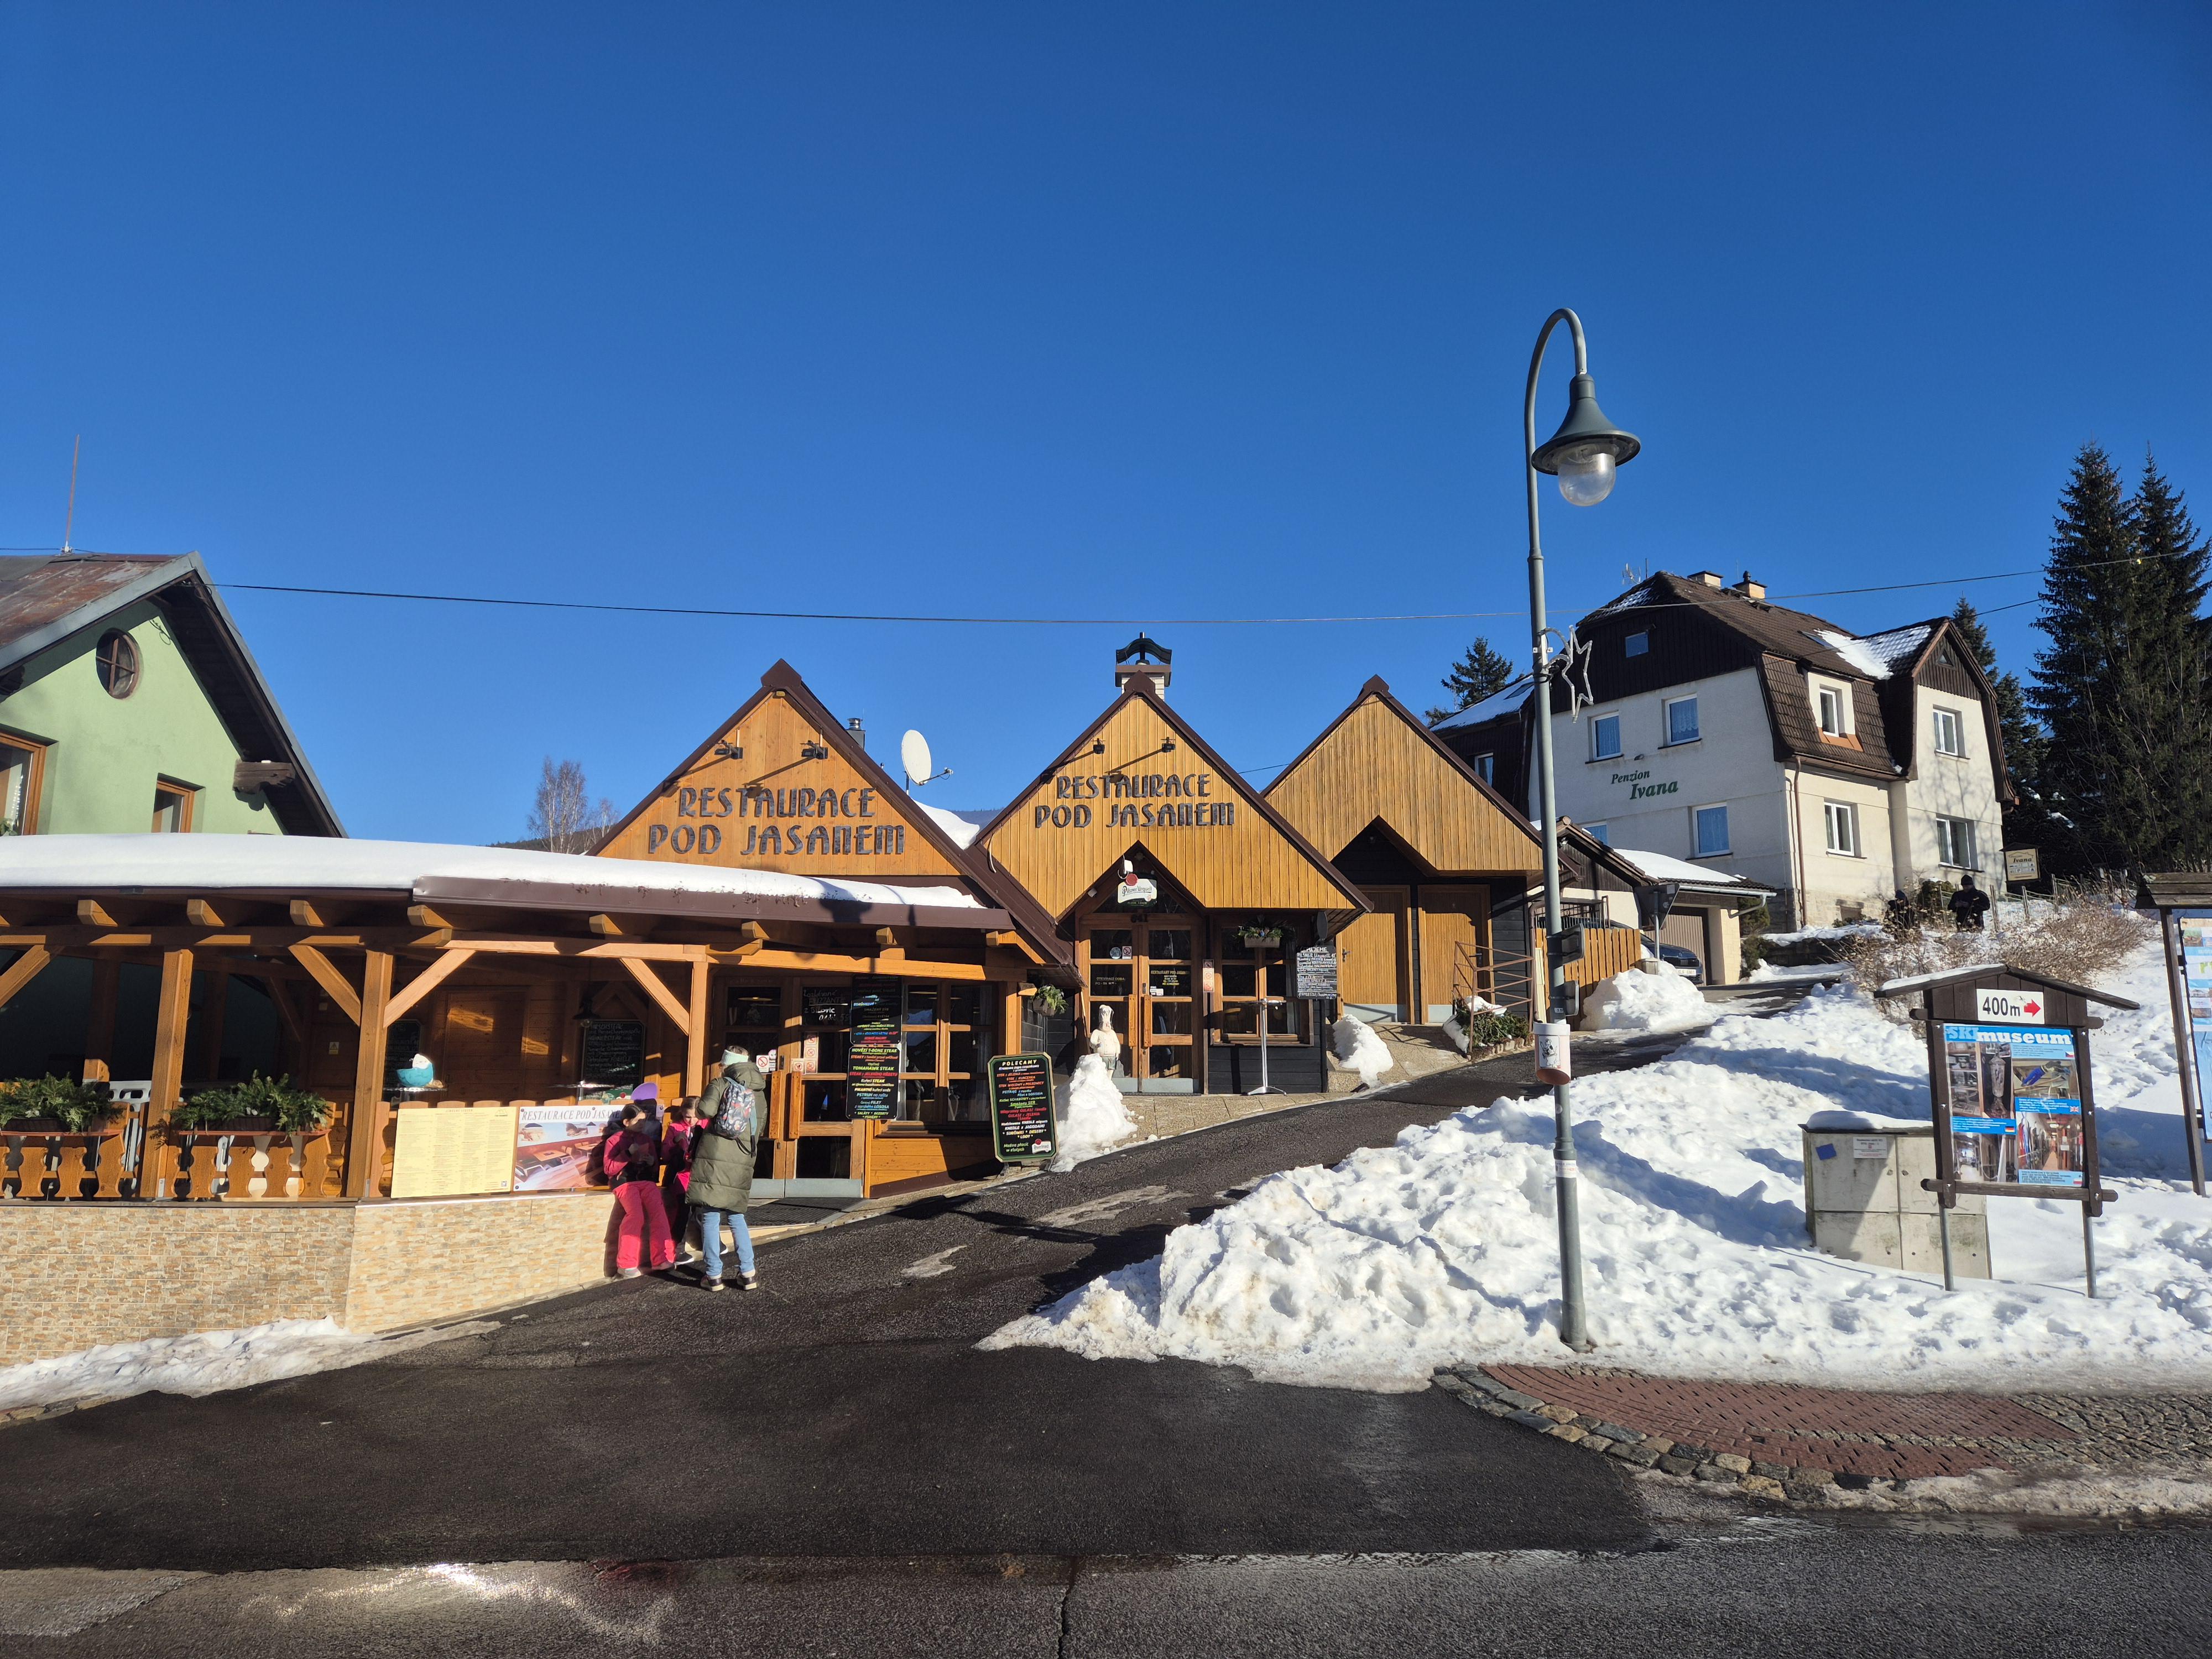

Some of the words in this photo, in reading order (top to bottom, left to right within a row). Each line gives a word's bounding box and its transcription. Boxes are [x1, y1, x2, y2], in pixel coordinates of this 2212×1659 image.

[1057, 773, 1211, 799] RESTAURACE
[1611, 770, 1650, 784] Penzion
[1630, 781, 1678, 800] Ivana
[678, 787, 876, 818] RESTAURACE
[1035, 804, 1092, 828] POD
[1105, 801, 1234, 827] JASANEM
[649, 824, 722, 854] POD
[740, 825, 905, 855] JASANEM
[1122, 885, 1137, 896] Pilsner
[1138, 885, 1152, 893] Urquell
[521, 1110, 574, 1121] RESTAURACE
[575, 1109, 590, 1120] POD
[591, 1109, 620, 1120] JASANE
